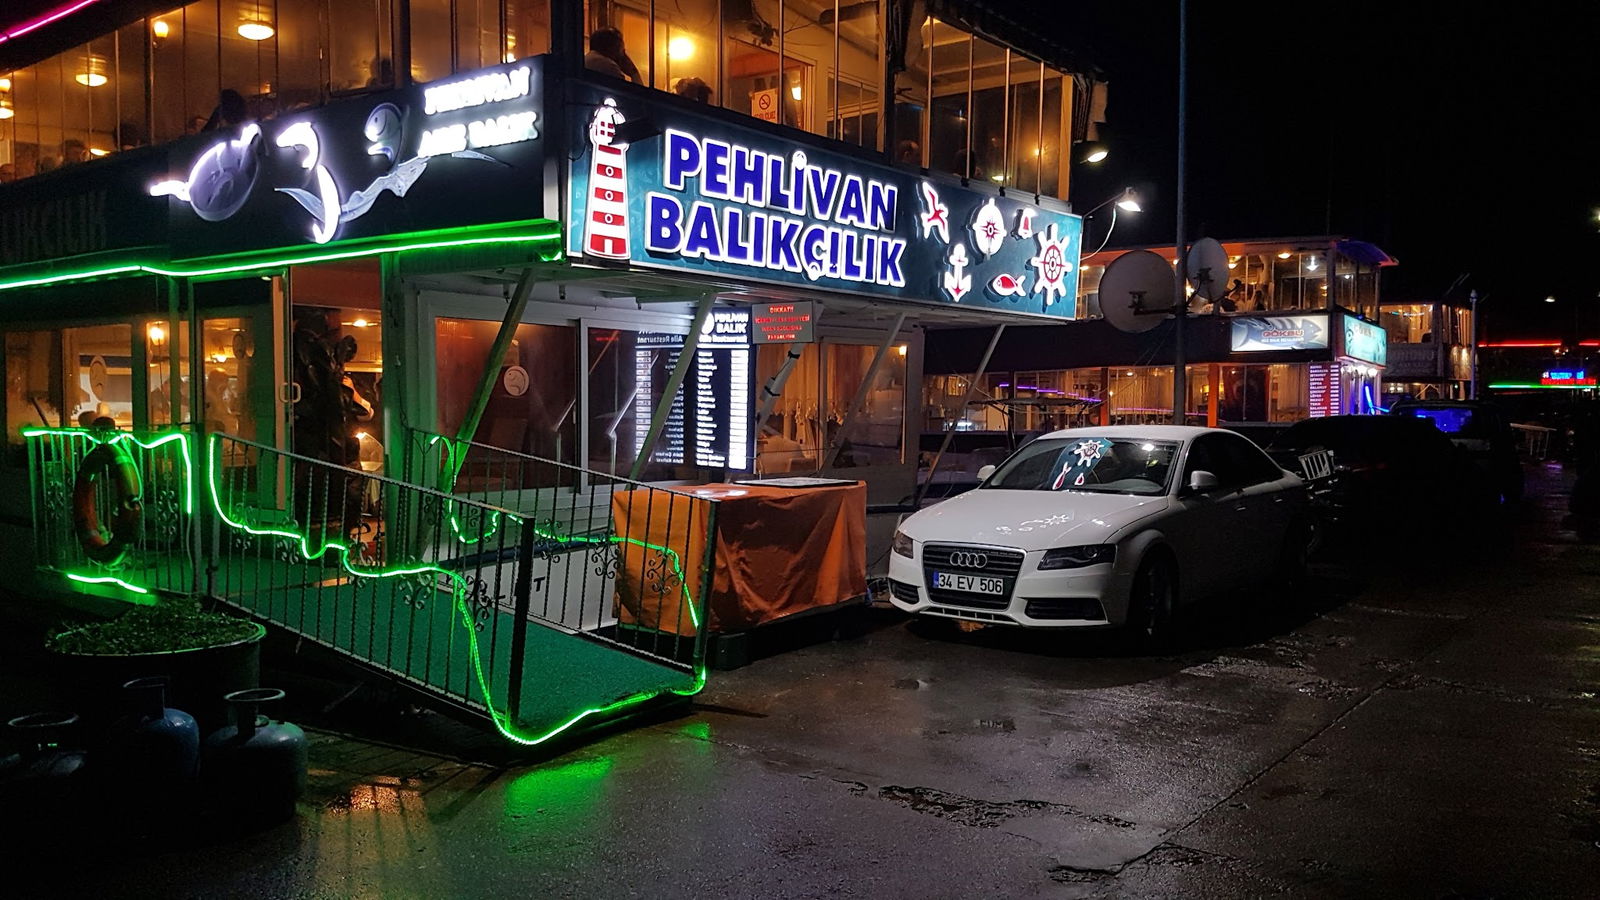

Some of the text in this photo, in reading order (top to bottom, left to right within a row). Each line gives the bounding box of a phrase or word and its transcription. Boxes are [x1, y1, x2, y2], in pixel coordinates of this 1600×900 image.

[664, 128, 897, 233] PEHLİVAN
[645, 191, 905, 287] BALIKÇILIK
[939, 574, 1002, 593] 34 EV 506
